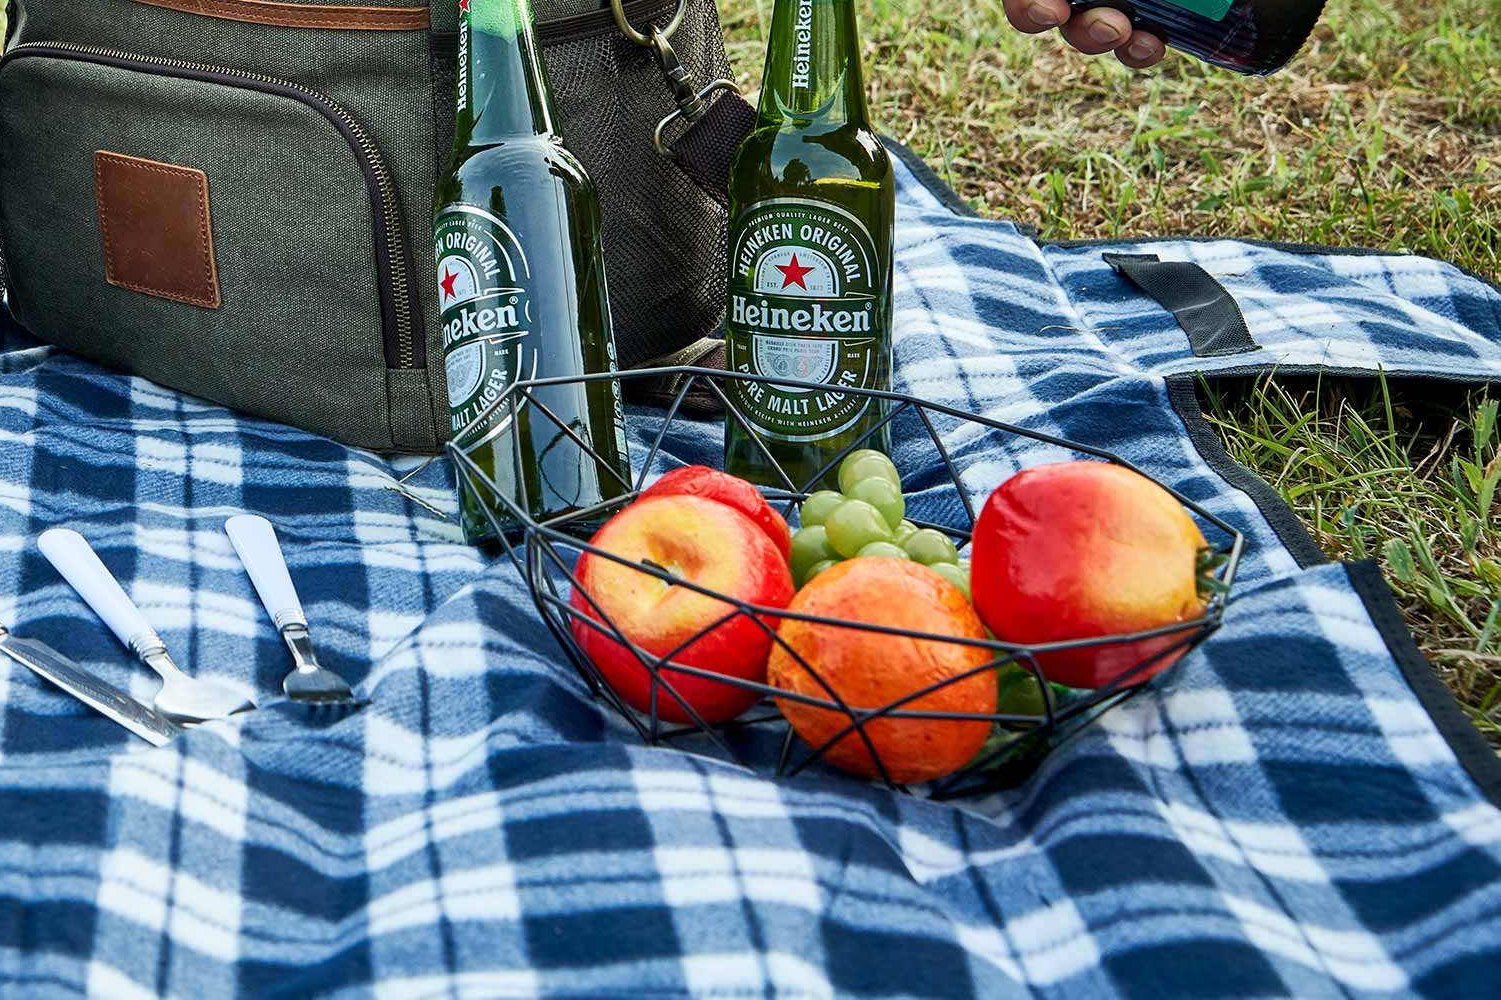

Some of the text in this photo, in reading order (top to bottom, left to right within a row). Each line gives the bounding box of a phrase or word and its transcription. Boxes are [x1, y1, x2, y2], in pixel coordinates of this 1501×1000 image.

[457, 19, 468, 113] Heineken
[809, 213, 831, 225] LAGER
[446, 231, 501, 280] ORIGINAL
[739, 223, 861, 284] HEINEKEN ORIGINAL
[443, 304, 519, 349] neken
[732, 294, 871, 333] Heineken
[473, 368, 508, 416] LAGER
[767, 395, 809, 416] MALT
